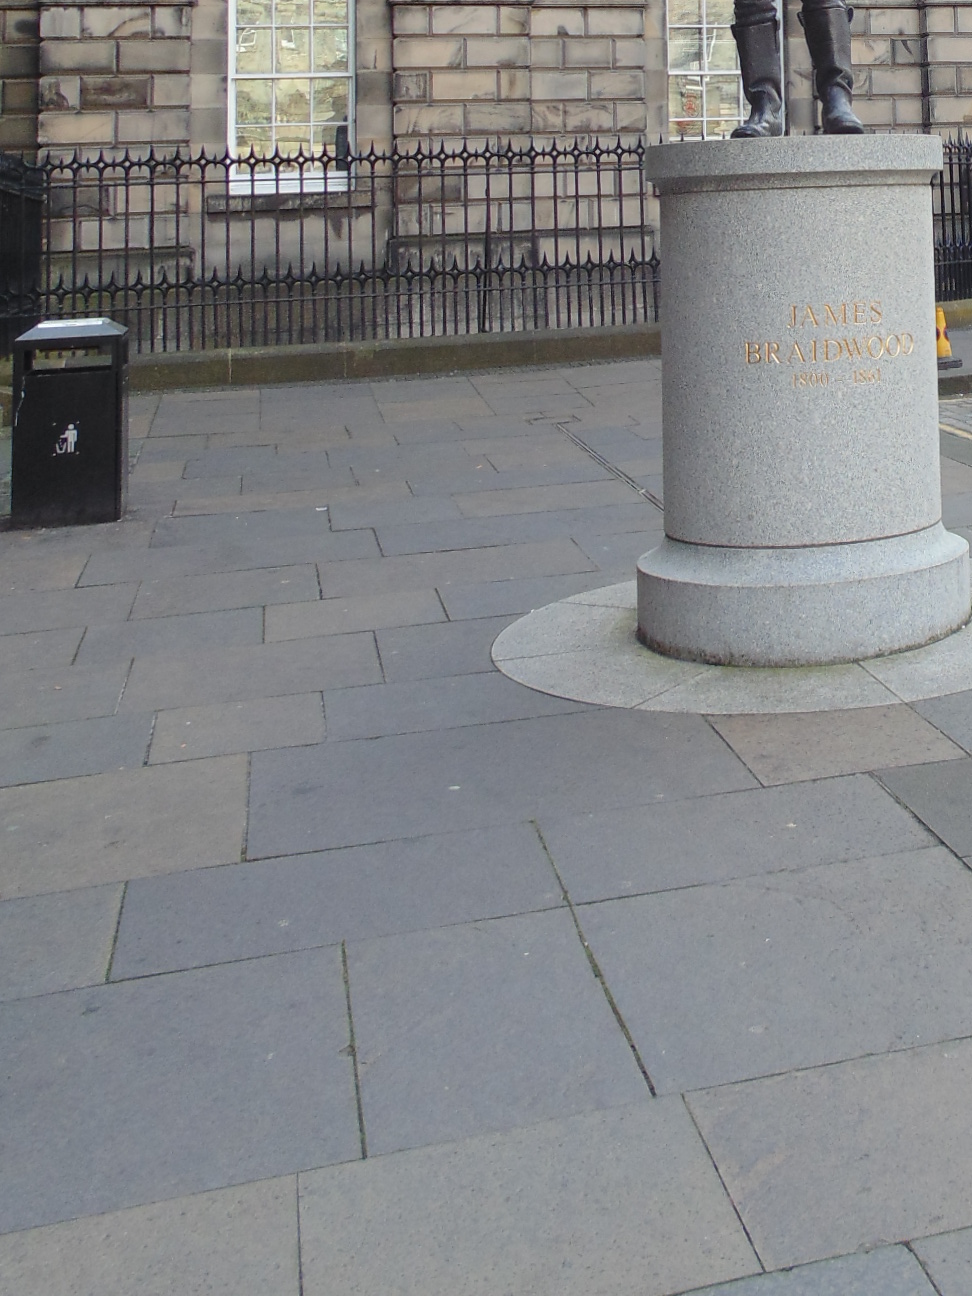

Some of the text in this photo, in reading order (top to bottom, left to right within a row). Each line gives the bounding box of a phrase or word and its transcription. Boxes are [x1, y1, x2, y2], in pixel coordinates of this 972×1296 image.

[786, 301, 882, 329] JAMES
[744, 333, 915, 365] BRAIDWOOD
[792, 371, 829, 389] 1800
[852, 367, 881, 385] 1861
